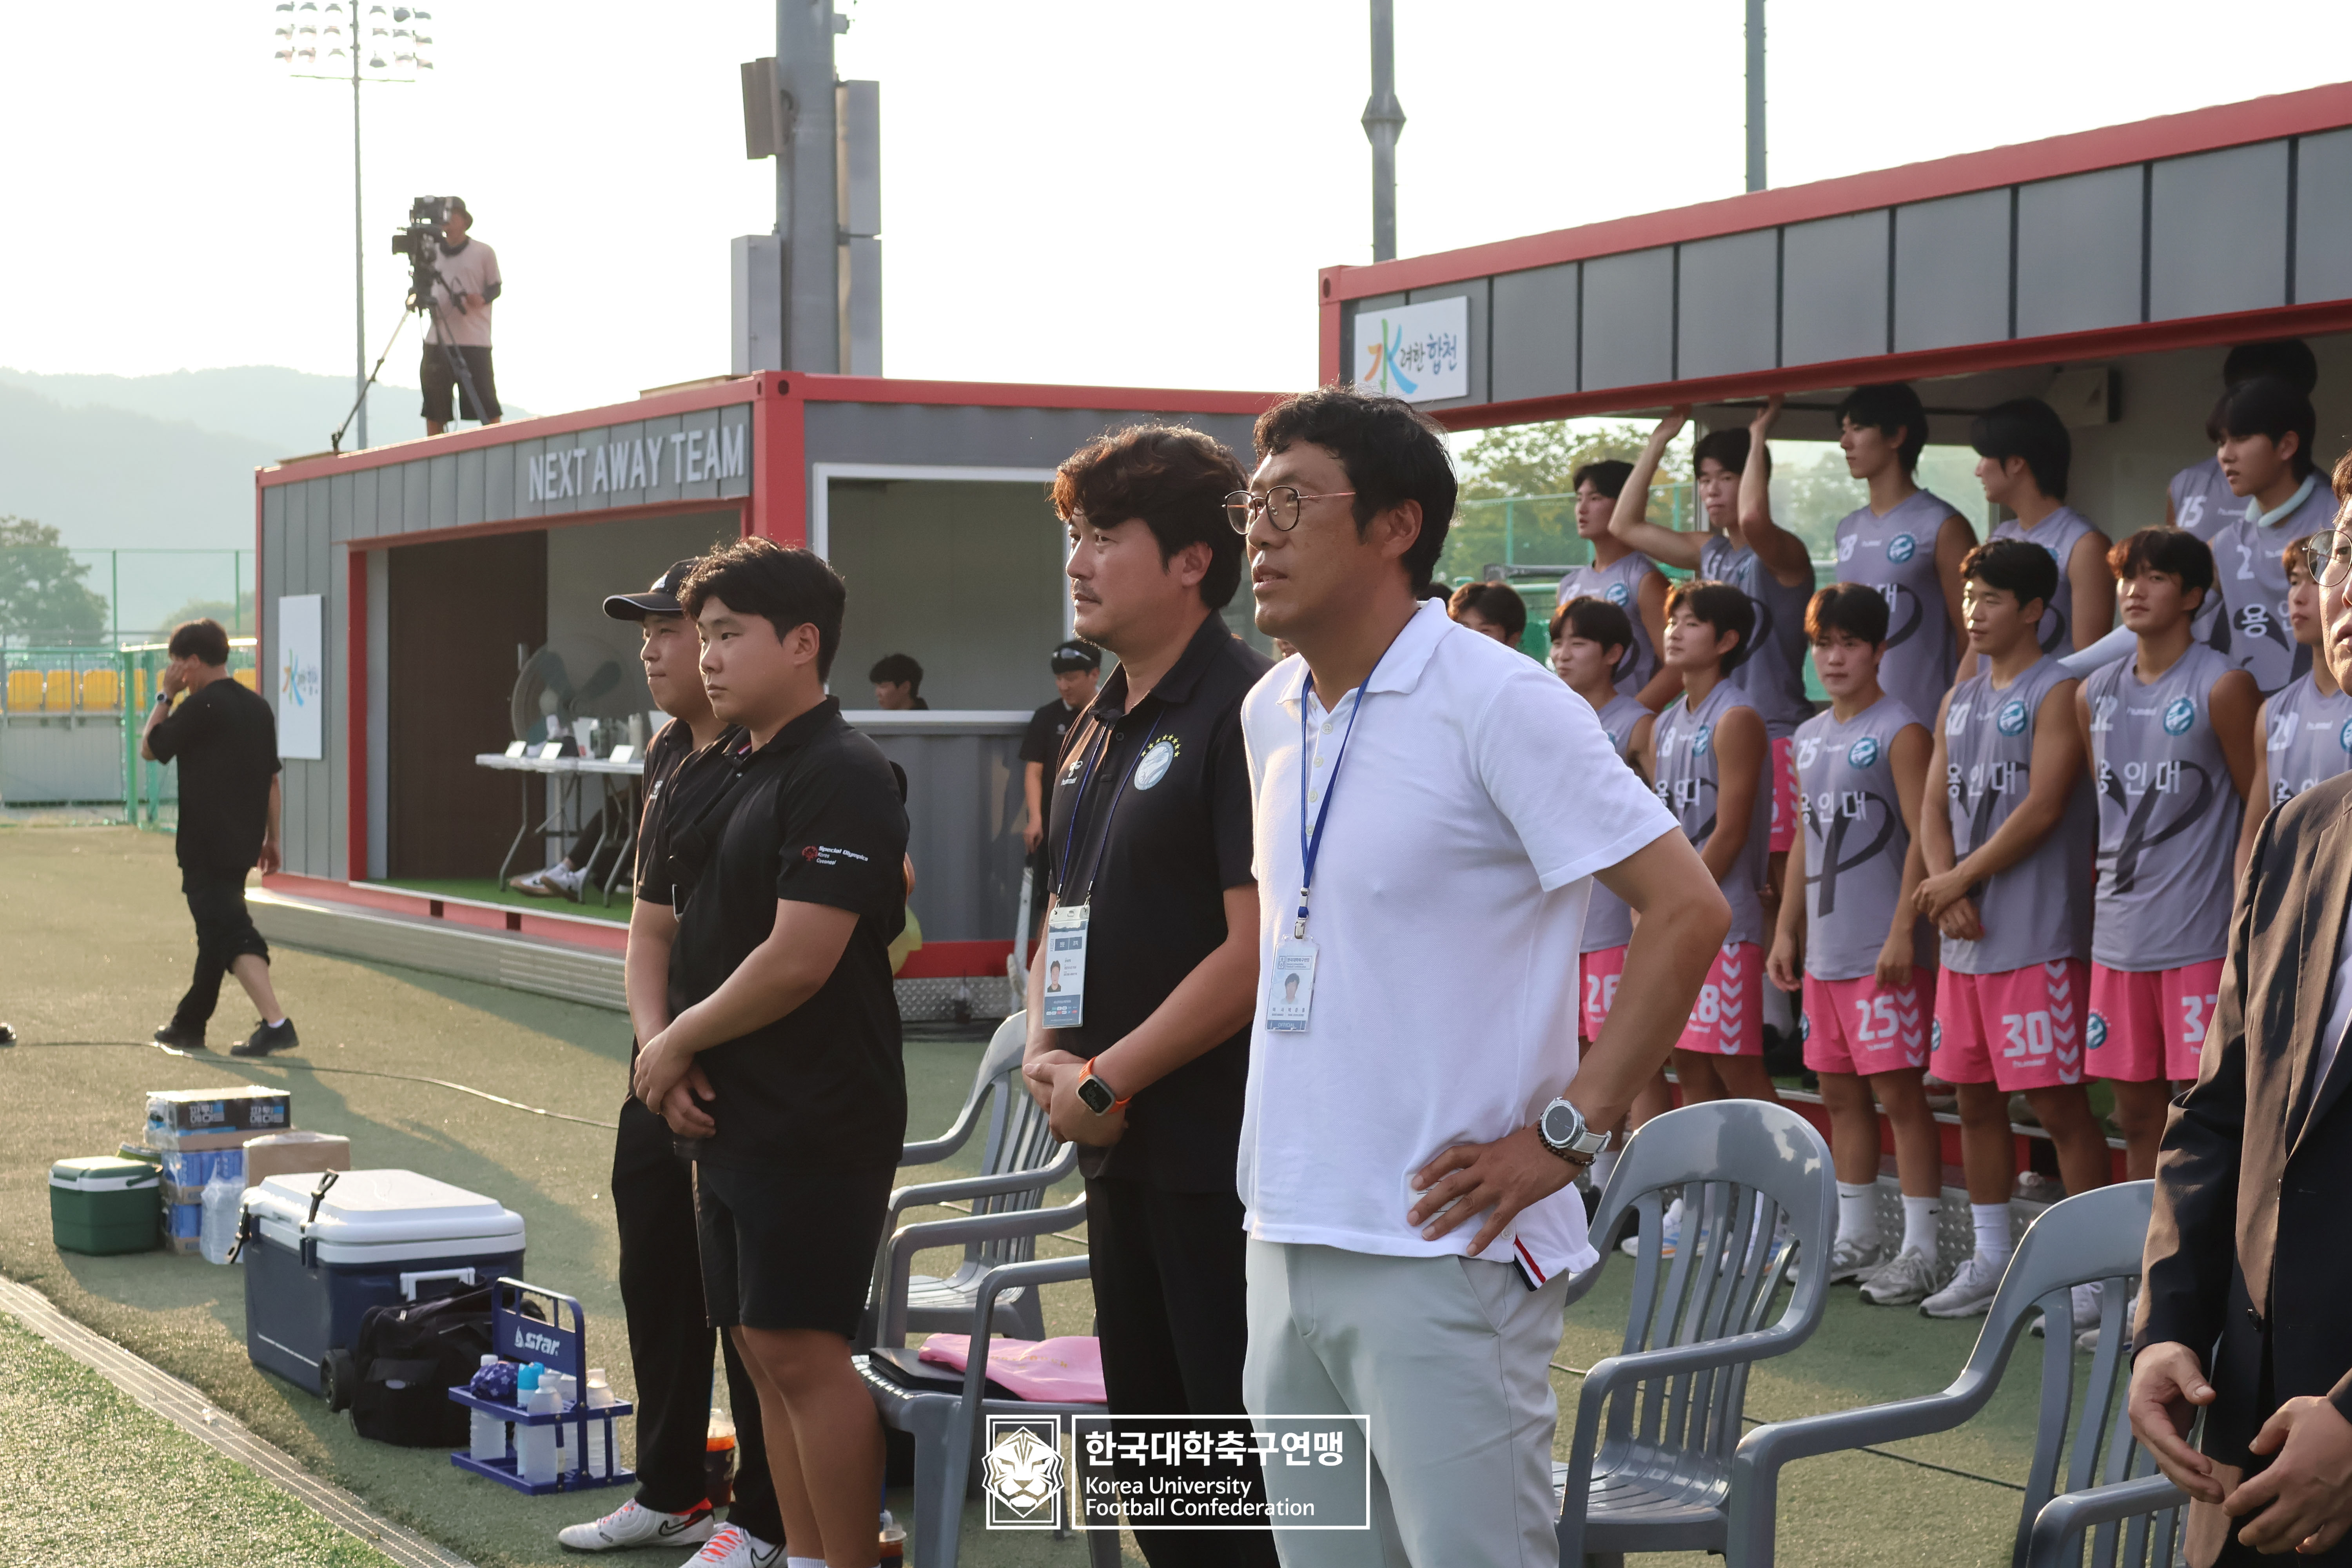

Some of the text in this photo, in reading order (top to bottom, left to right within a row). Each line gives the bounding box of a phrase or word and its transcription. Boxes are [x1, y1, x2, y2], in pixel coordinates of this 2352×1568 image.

[529, 423, 744, 502] NEXT AWAY TEAM
[2176, 495, 2207, 528] 15
[2236, 544, 2255, 580] 2
[1060, 776, 1078, 786] hummel
[1947, 761, 2016, 798] 용인대
[818, 845, 869, 862] Special Olympics
[1689, 984, 1720, 1023] 8
[1855, 994, 1900, 1042] 25
[2002, 1010, 2054, 1058] 30
[524, 1332, 561, 1355] star
